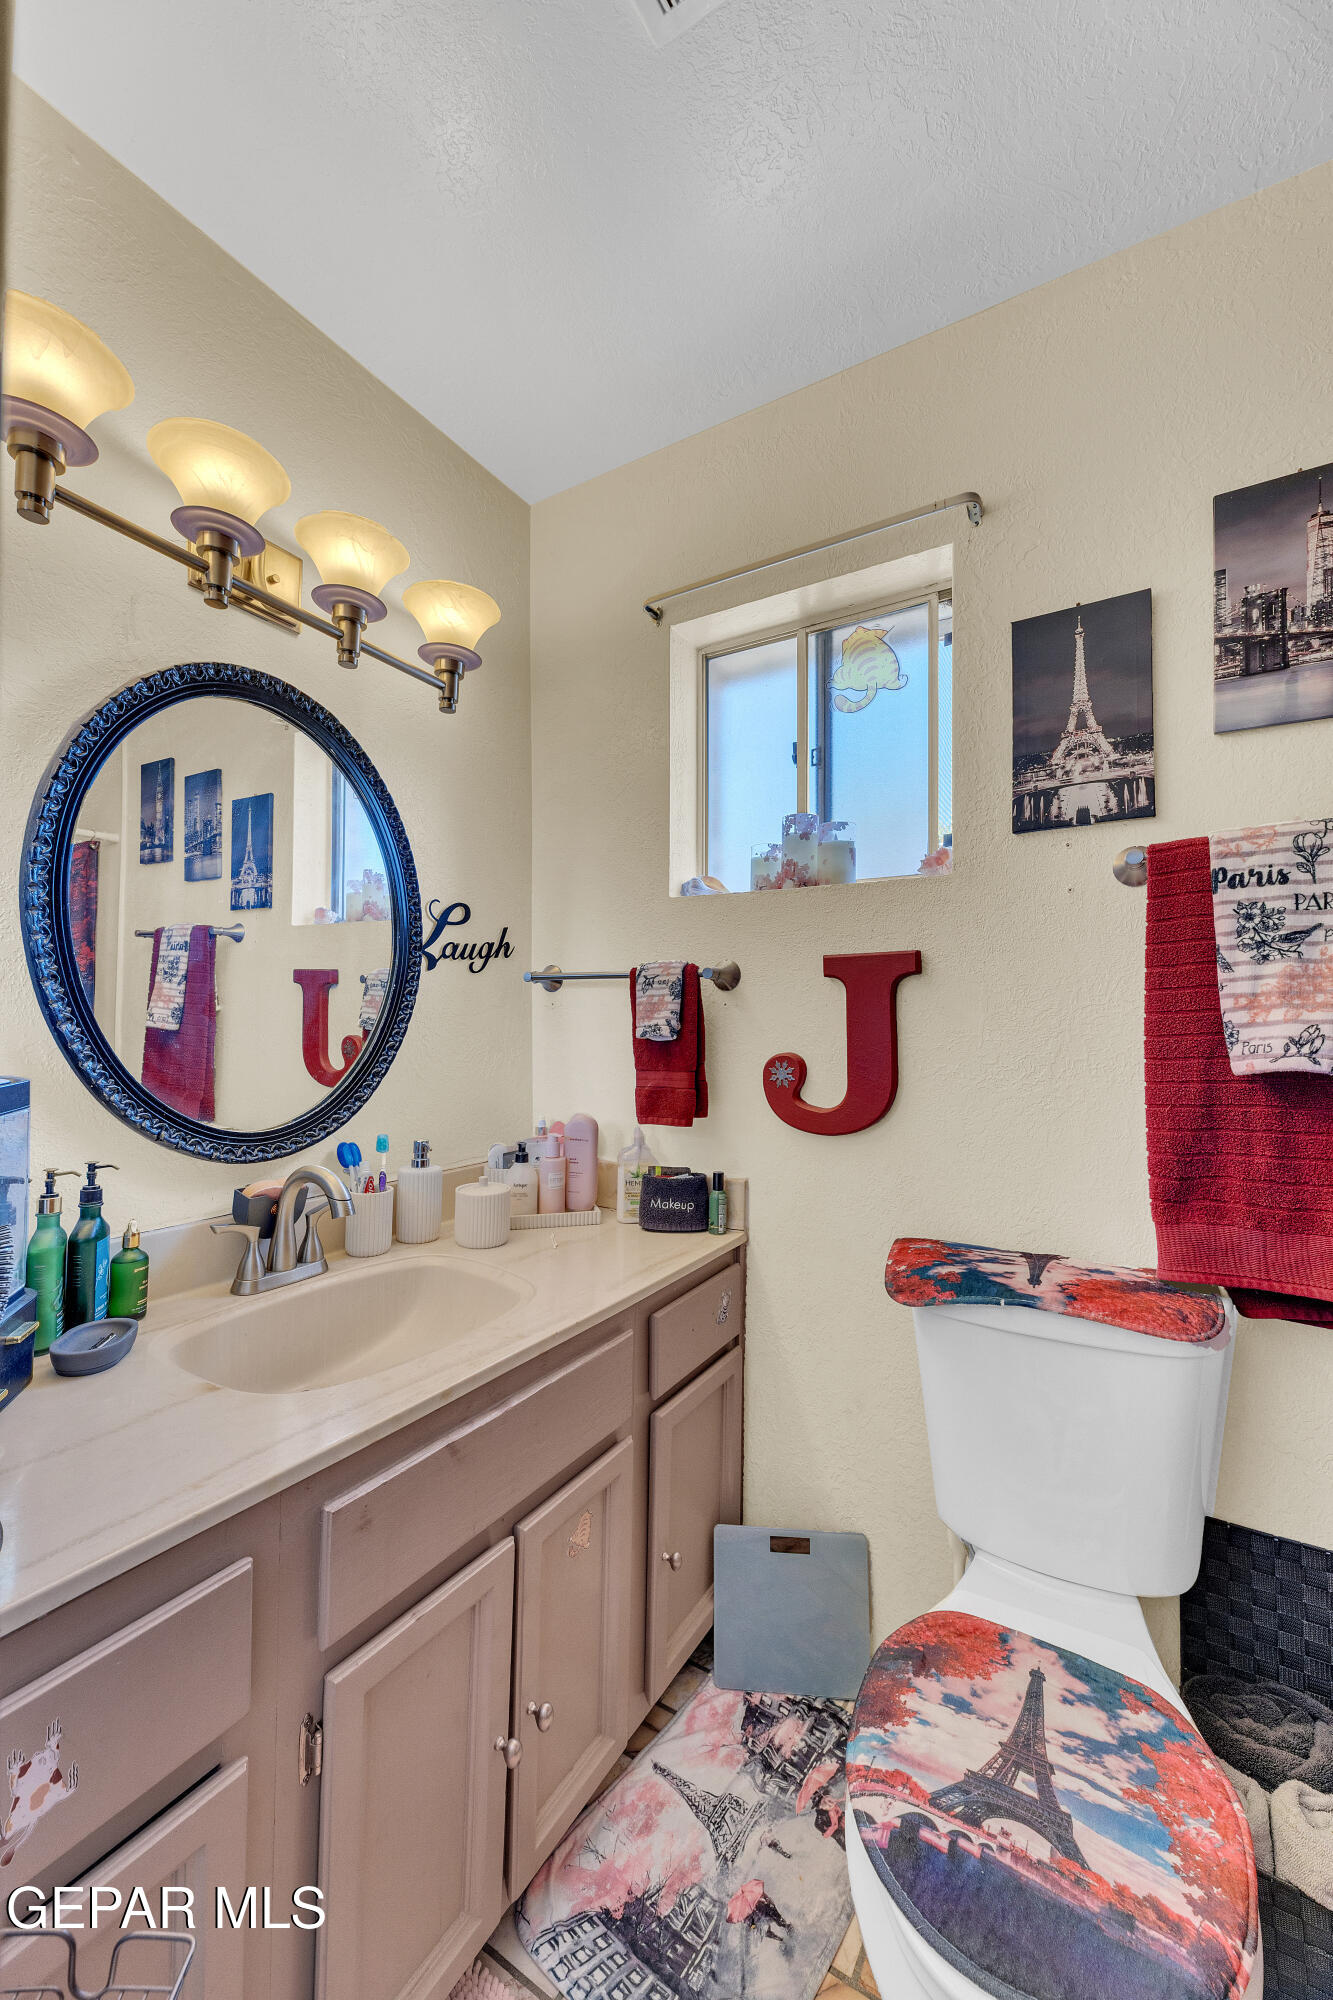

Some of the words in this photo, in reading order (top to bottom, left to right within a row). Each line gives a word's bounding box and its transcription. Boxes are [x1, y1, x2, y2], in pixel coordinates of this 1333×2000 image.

[1212, 864, 1292, 895] Paris
[421, 899, 515, 974] Laugh
[763, 950, 923, 1136] J
[1241, 1041, 1273, 1056] Paris
[650, 1198, 695, 1213] Makeup
